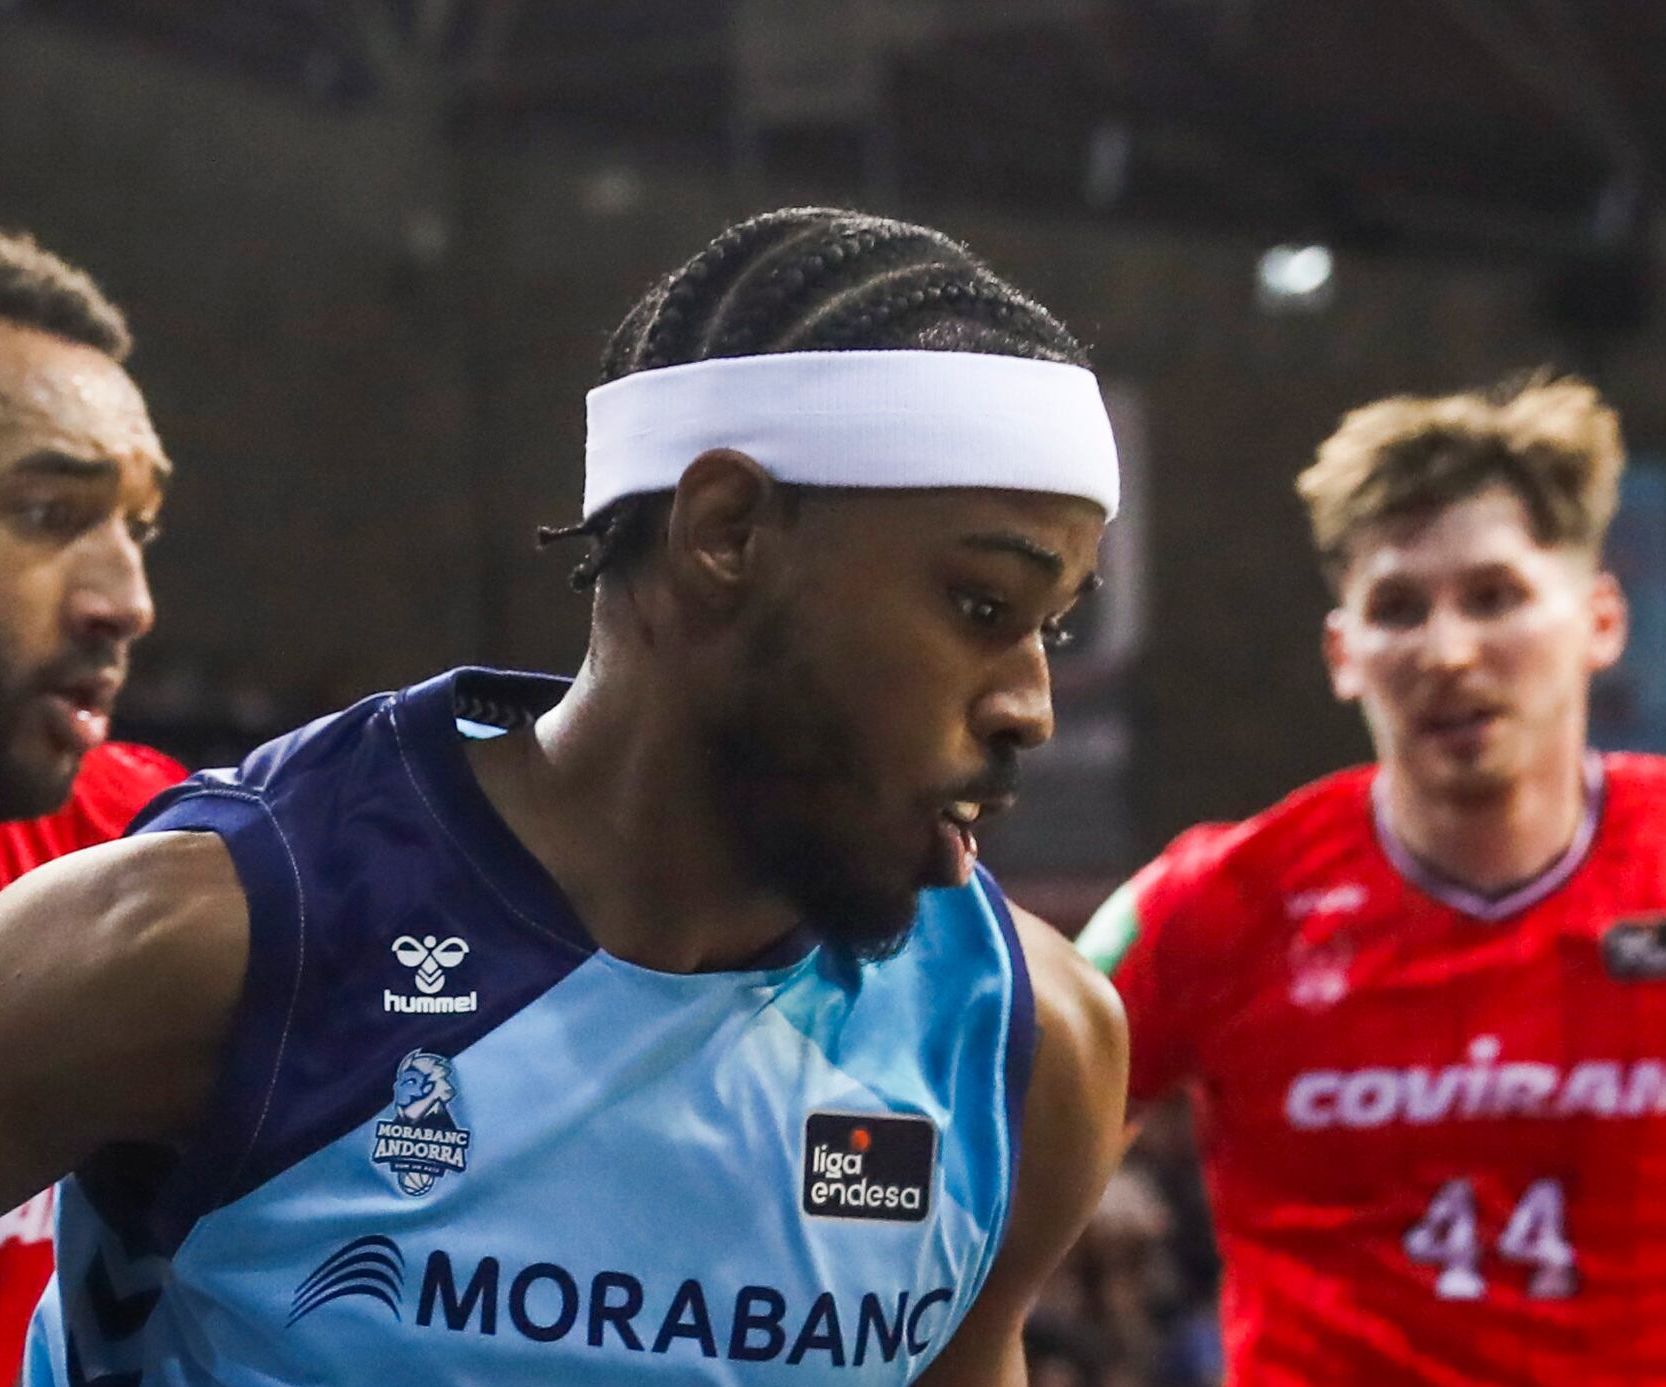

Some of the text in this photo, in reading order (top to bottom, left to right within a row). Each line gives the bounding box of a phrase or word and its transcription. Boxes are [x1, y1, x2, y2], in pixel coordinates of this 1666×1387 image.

[383, 989, 478, 1013] hummel
[377, 1123, 469, 1146] MORABANC
[374, 1139, 465, 1168] ANDORRA
[813, 1144, 862, 1179] liga
[811, 1177, 920, 1210] endesa
[1402, 1177, 1579, 1299] 44
[416, 1249, 955, 1367] MORABANC
